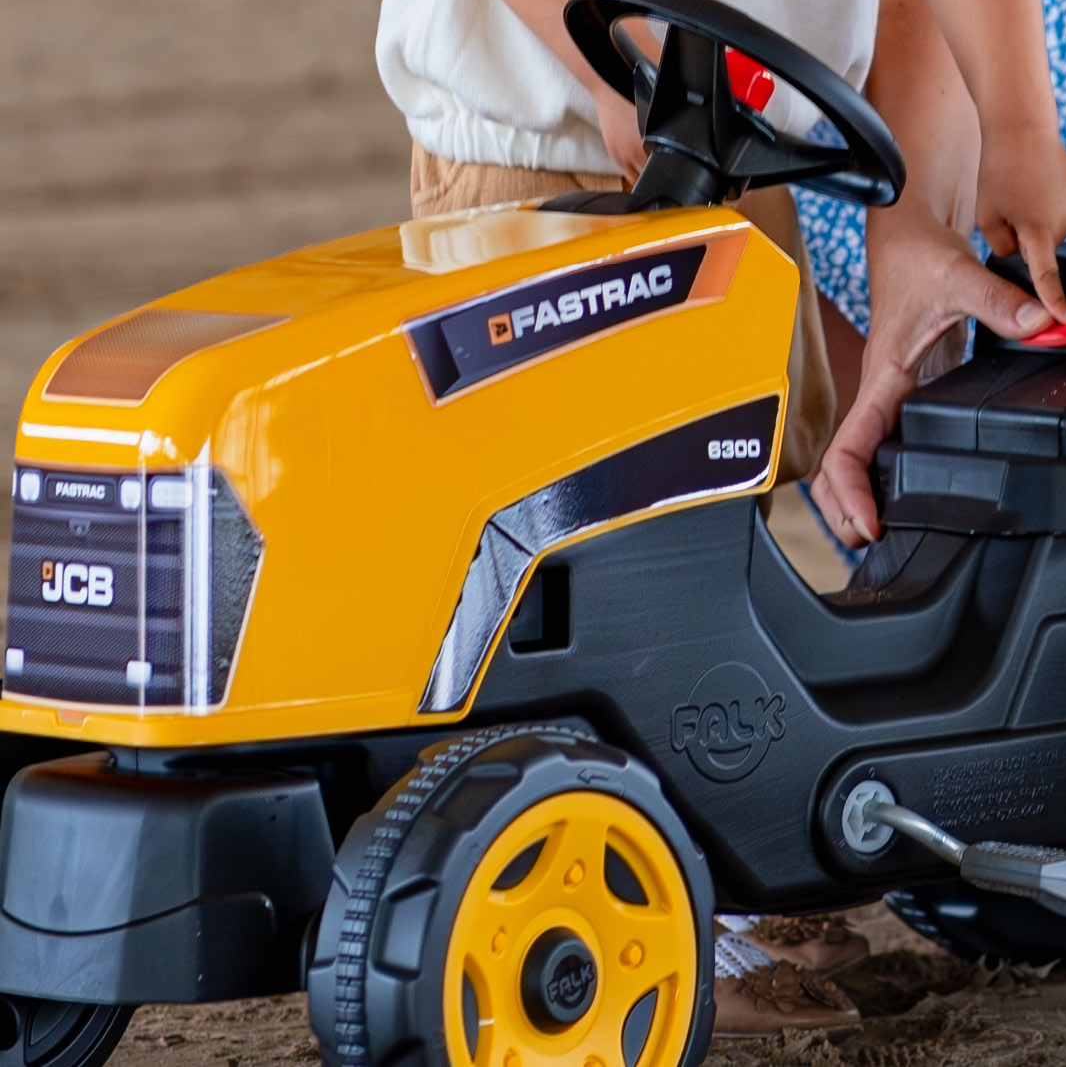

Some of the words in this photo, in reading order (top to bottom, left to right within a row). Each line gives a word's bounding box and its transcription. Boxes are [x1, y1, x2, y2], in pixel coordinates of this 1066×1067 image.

[511, 264, 673, 339] FASTRAC
[707, 438, 761, 460] 6300
[55, 482, 106, 500] FASTRAC
[41, 562, 114, 607] JCB
[671, 691, 787, 753] FALK
[548, 963, 595, 1004] FALK
